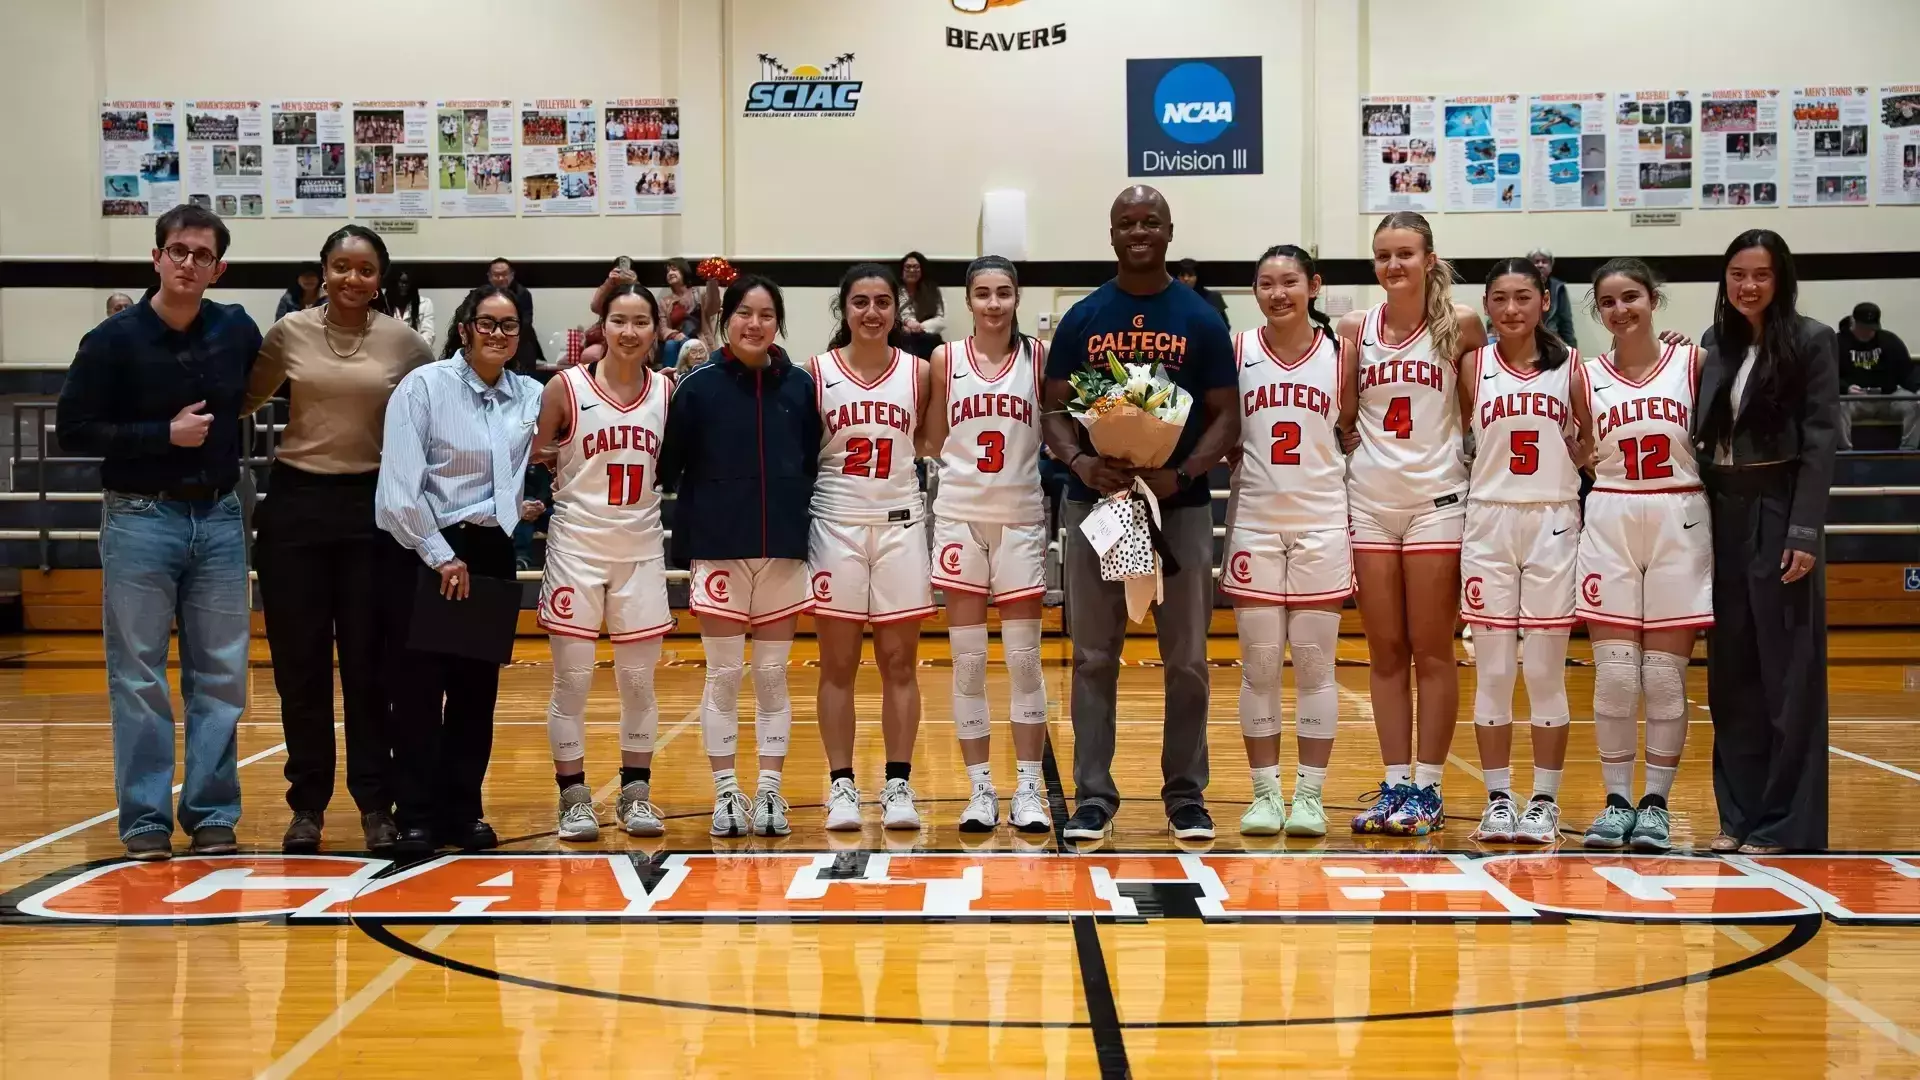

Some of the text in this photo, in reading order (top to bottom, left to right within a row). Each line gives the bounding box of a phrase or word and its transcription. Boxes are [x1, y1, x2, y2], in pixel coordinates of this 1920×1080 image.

[946, 23, 1067, 51] BEAVERS
[535, 99, 576, 109] VOLLEYBALL
[747, 83, 862, 110] SCIAC
[1744, 89, 1767, 98] TENNIS
[1828, 87, 1853, 97] TENNIS
[1162, 101, 1233, 124] NCAA
[1143, 149, 1247, 171] Division III
[1087, 331, 1187, 355] CALTECH
[1089, 351, 1183, 364] BAKETBALL
[1359, 360, 1443, 392] CALTECH
[826, 400, 911, 436] CALTECH
[950, 393, 1032, 428] CALTECH
[1243, 383, 1331, 420] CALTECH
[1383, 397, 1413, 439] 4
[1480, 392, 1568, 431] CALTECH
[1597, 397, 1688, 442] CALTECH
[842, 437, 893, 480] 21
[976, 430, 1005, 474] 3
[1271, 421, 1301, 465] 2
[1509, 430, 1540, 476] 5
[1618, 433, 1674, 480] 12
[607, 463, 644, 505] 11
